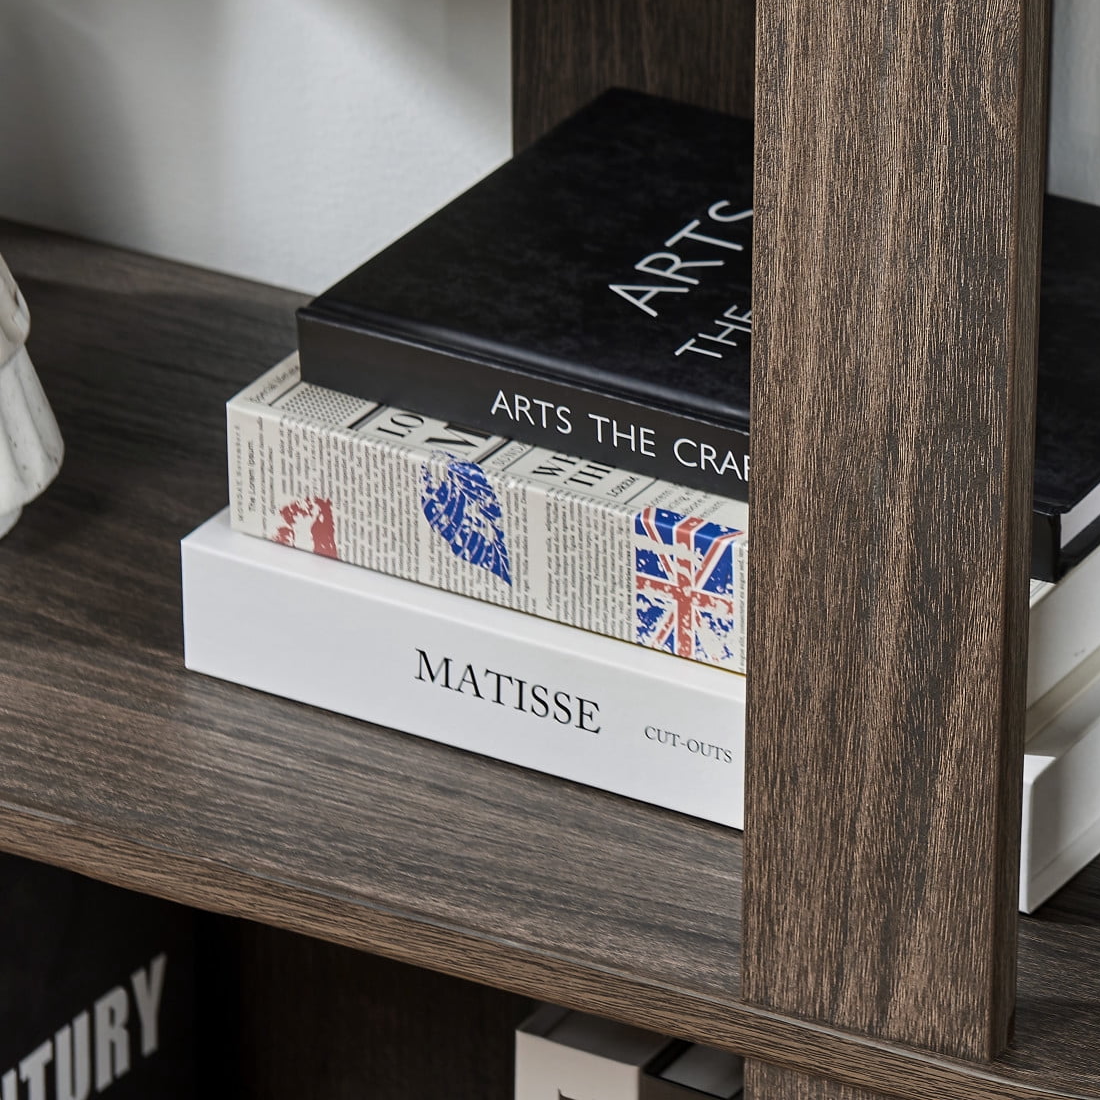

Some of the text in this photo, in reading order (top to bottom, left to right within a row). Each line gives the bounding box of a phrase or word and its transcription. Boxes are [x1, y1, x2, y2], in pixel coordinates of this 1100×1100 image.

[608, 199, 753, 318] ARTS
[674, 304, 752, 359] THE
[490, 389, 573, 435] ARTS
[588, 413, 657, 458] THE
[414, 648, 733, 764] MATISSE CUT-OUTS
